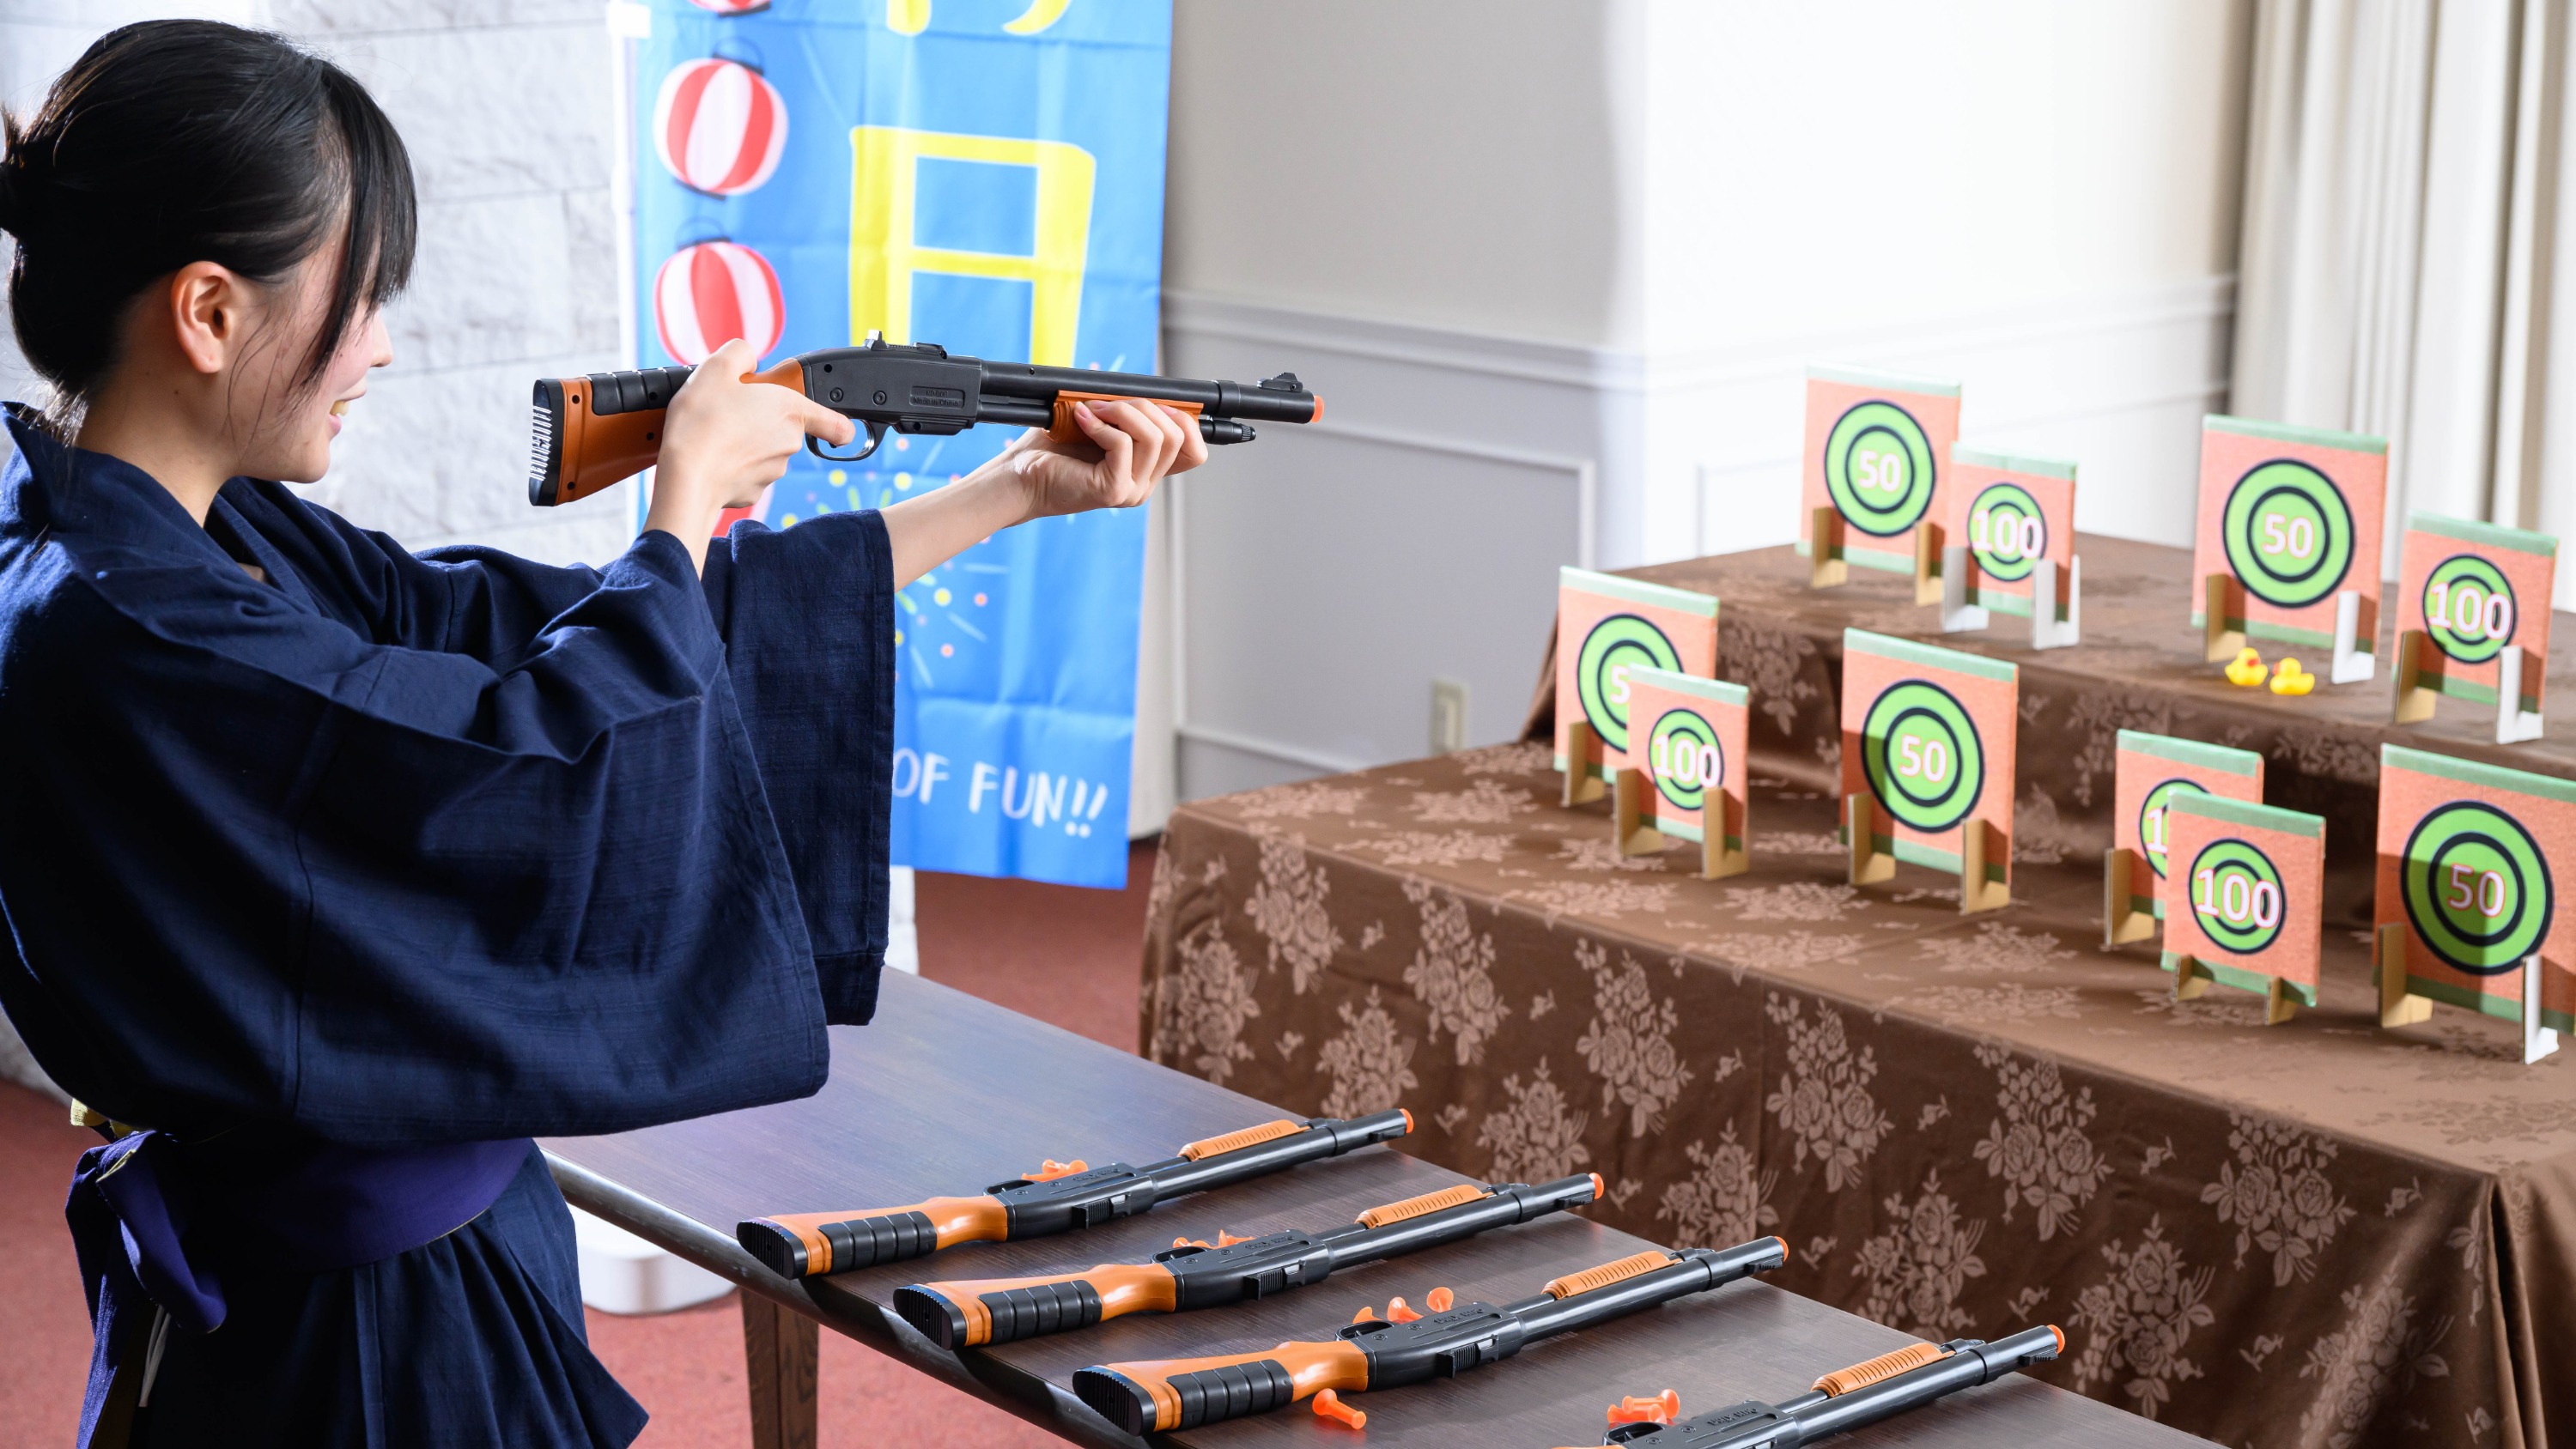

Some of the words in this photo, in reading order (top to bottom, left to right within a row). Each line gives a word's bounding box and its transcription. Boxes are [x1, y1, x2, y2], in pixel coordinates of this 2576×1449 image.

[849, 0, 1096, 369] 日
[1858, 450, 1901, 492] 50
[1973, 510, 2043, 560] 100
[2263, 514, 2314, 558] 50
[2428, 583, 2512, 640] 100
[1610, 664, 1630, 704] 5
[1653, 736, 1720, 788] 100
[1899, 736, 1947, 782] 50
[892, 747, 951, 804] OF
[969, 761, 1109, 839] FUN!!
[2195, 868, 2281, 929] 100
[2447, 864, 2506, 918] 50
